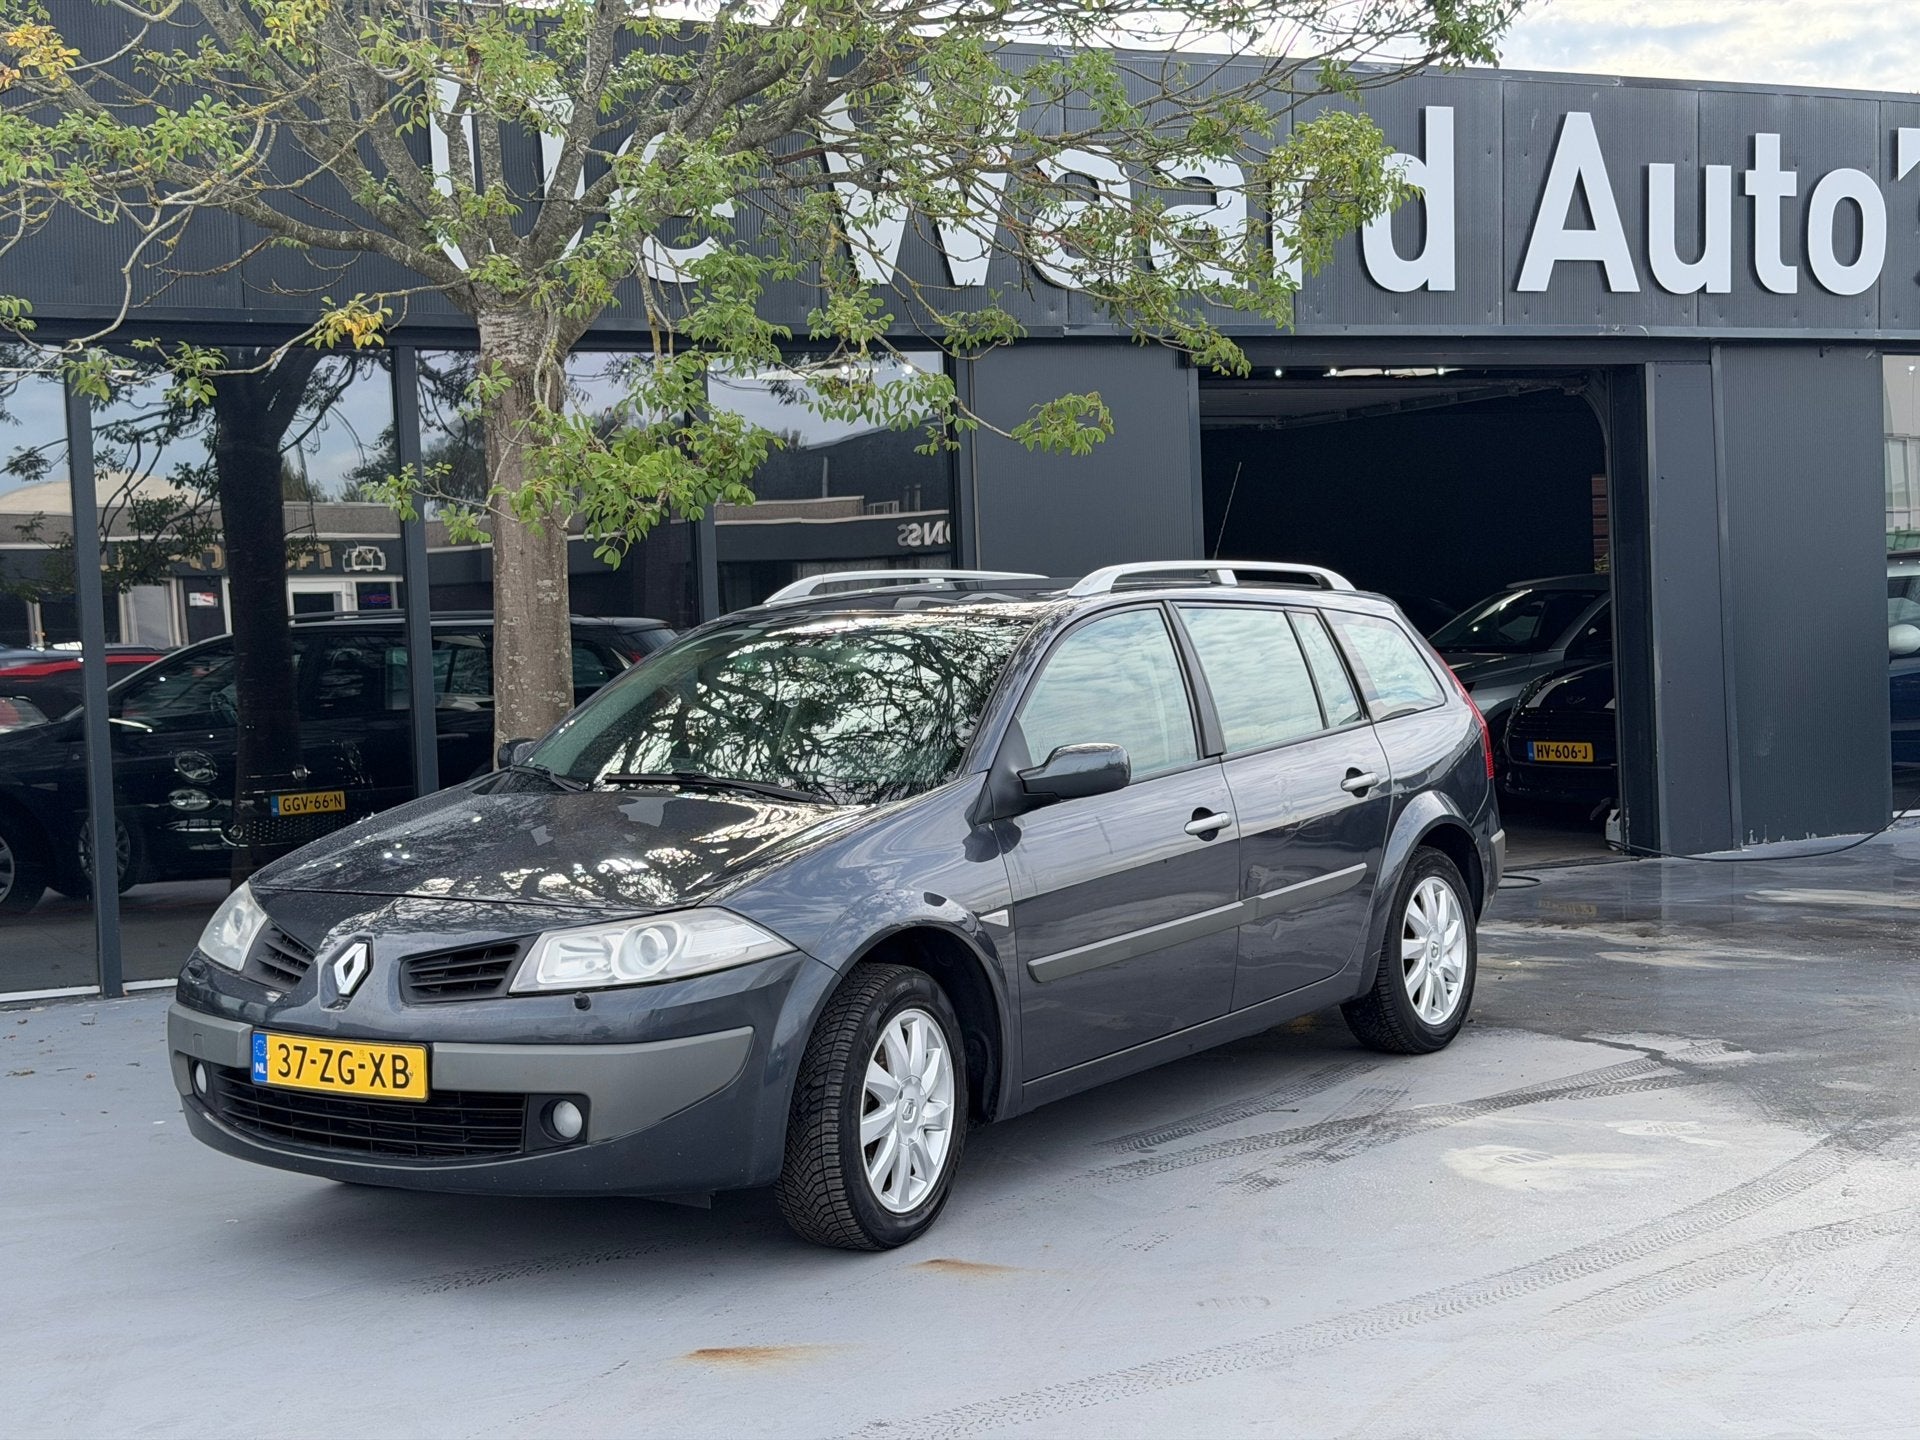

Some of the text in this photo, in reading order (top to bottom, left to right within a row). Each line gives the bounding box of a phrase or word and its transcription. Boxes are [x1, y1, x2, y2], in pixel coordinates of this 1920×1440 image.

[1536, 744, 1588, 759] HV-606-J
[282, 793, 342, 812] GGV-66-N
[255, 1043, 410, 1089] NL 37-ZG-XB
